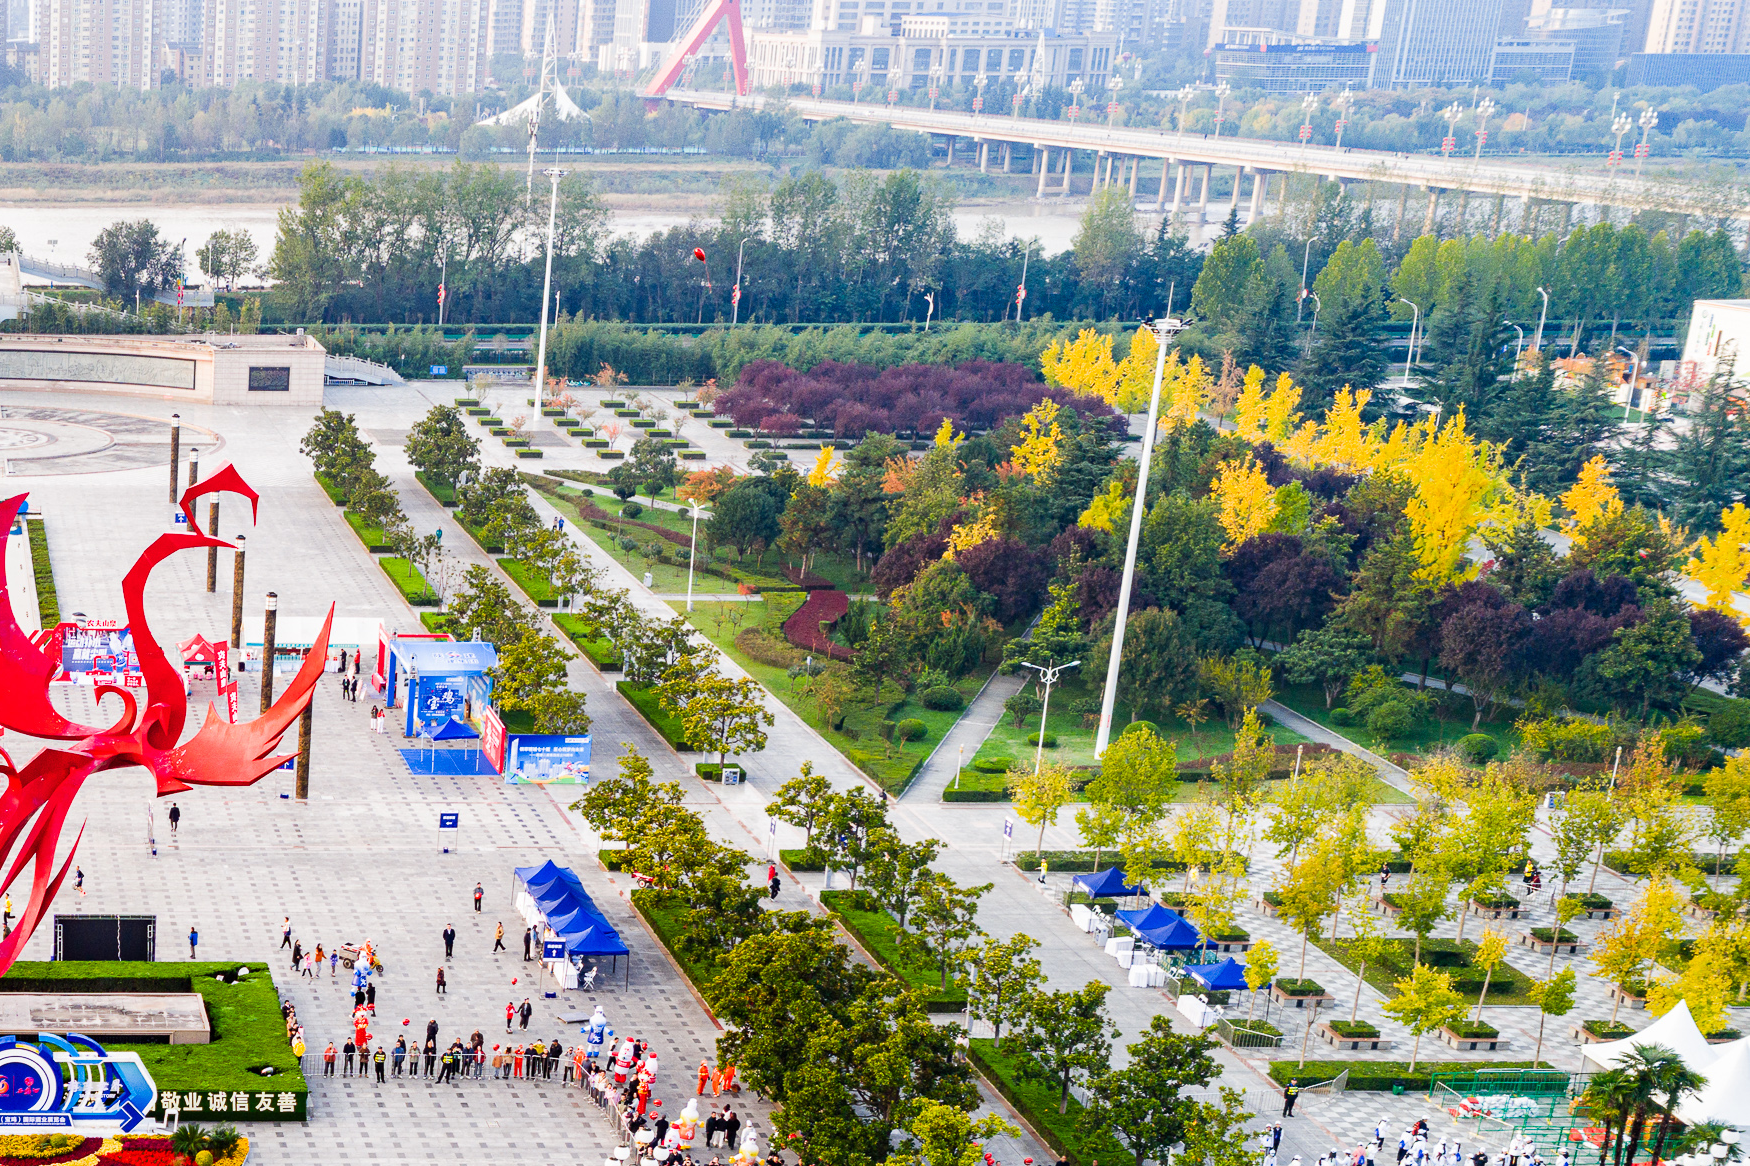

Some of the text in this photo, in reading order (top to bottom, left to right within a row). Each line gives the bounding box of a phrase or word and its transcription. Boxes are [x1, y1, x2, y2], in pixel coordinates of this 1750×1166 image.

[162, 1091, 298, 1111] 敬业 诚信 友善
